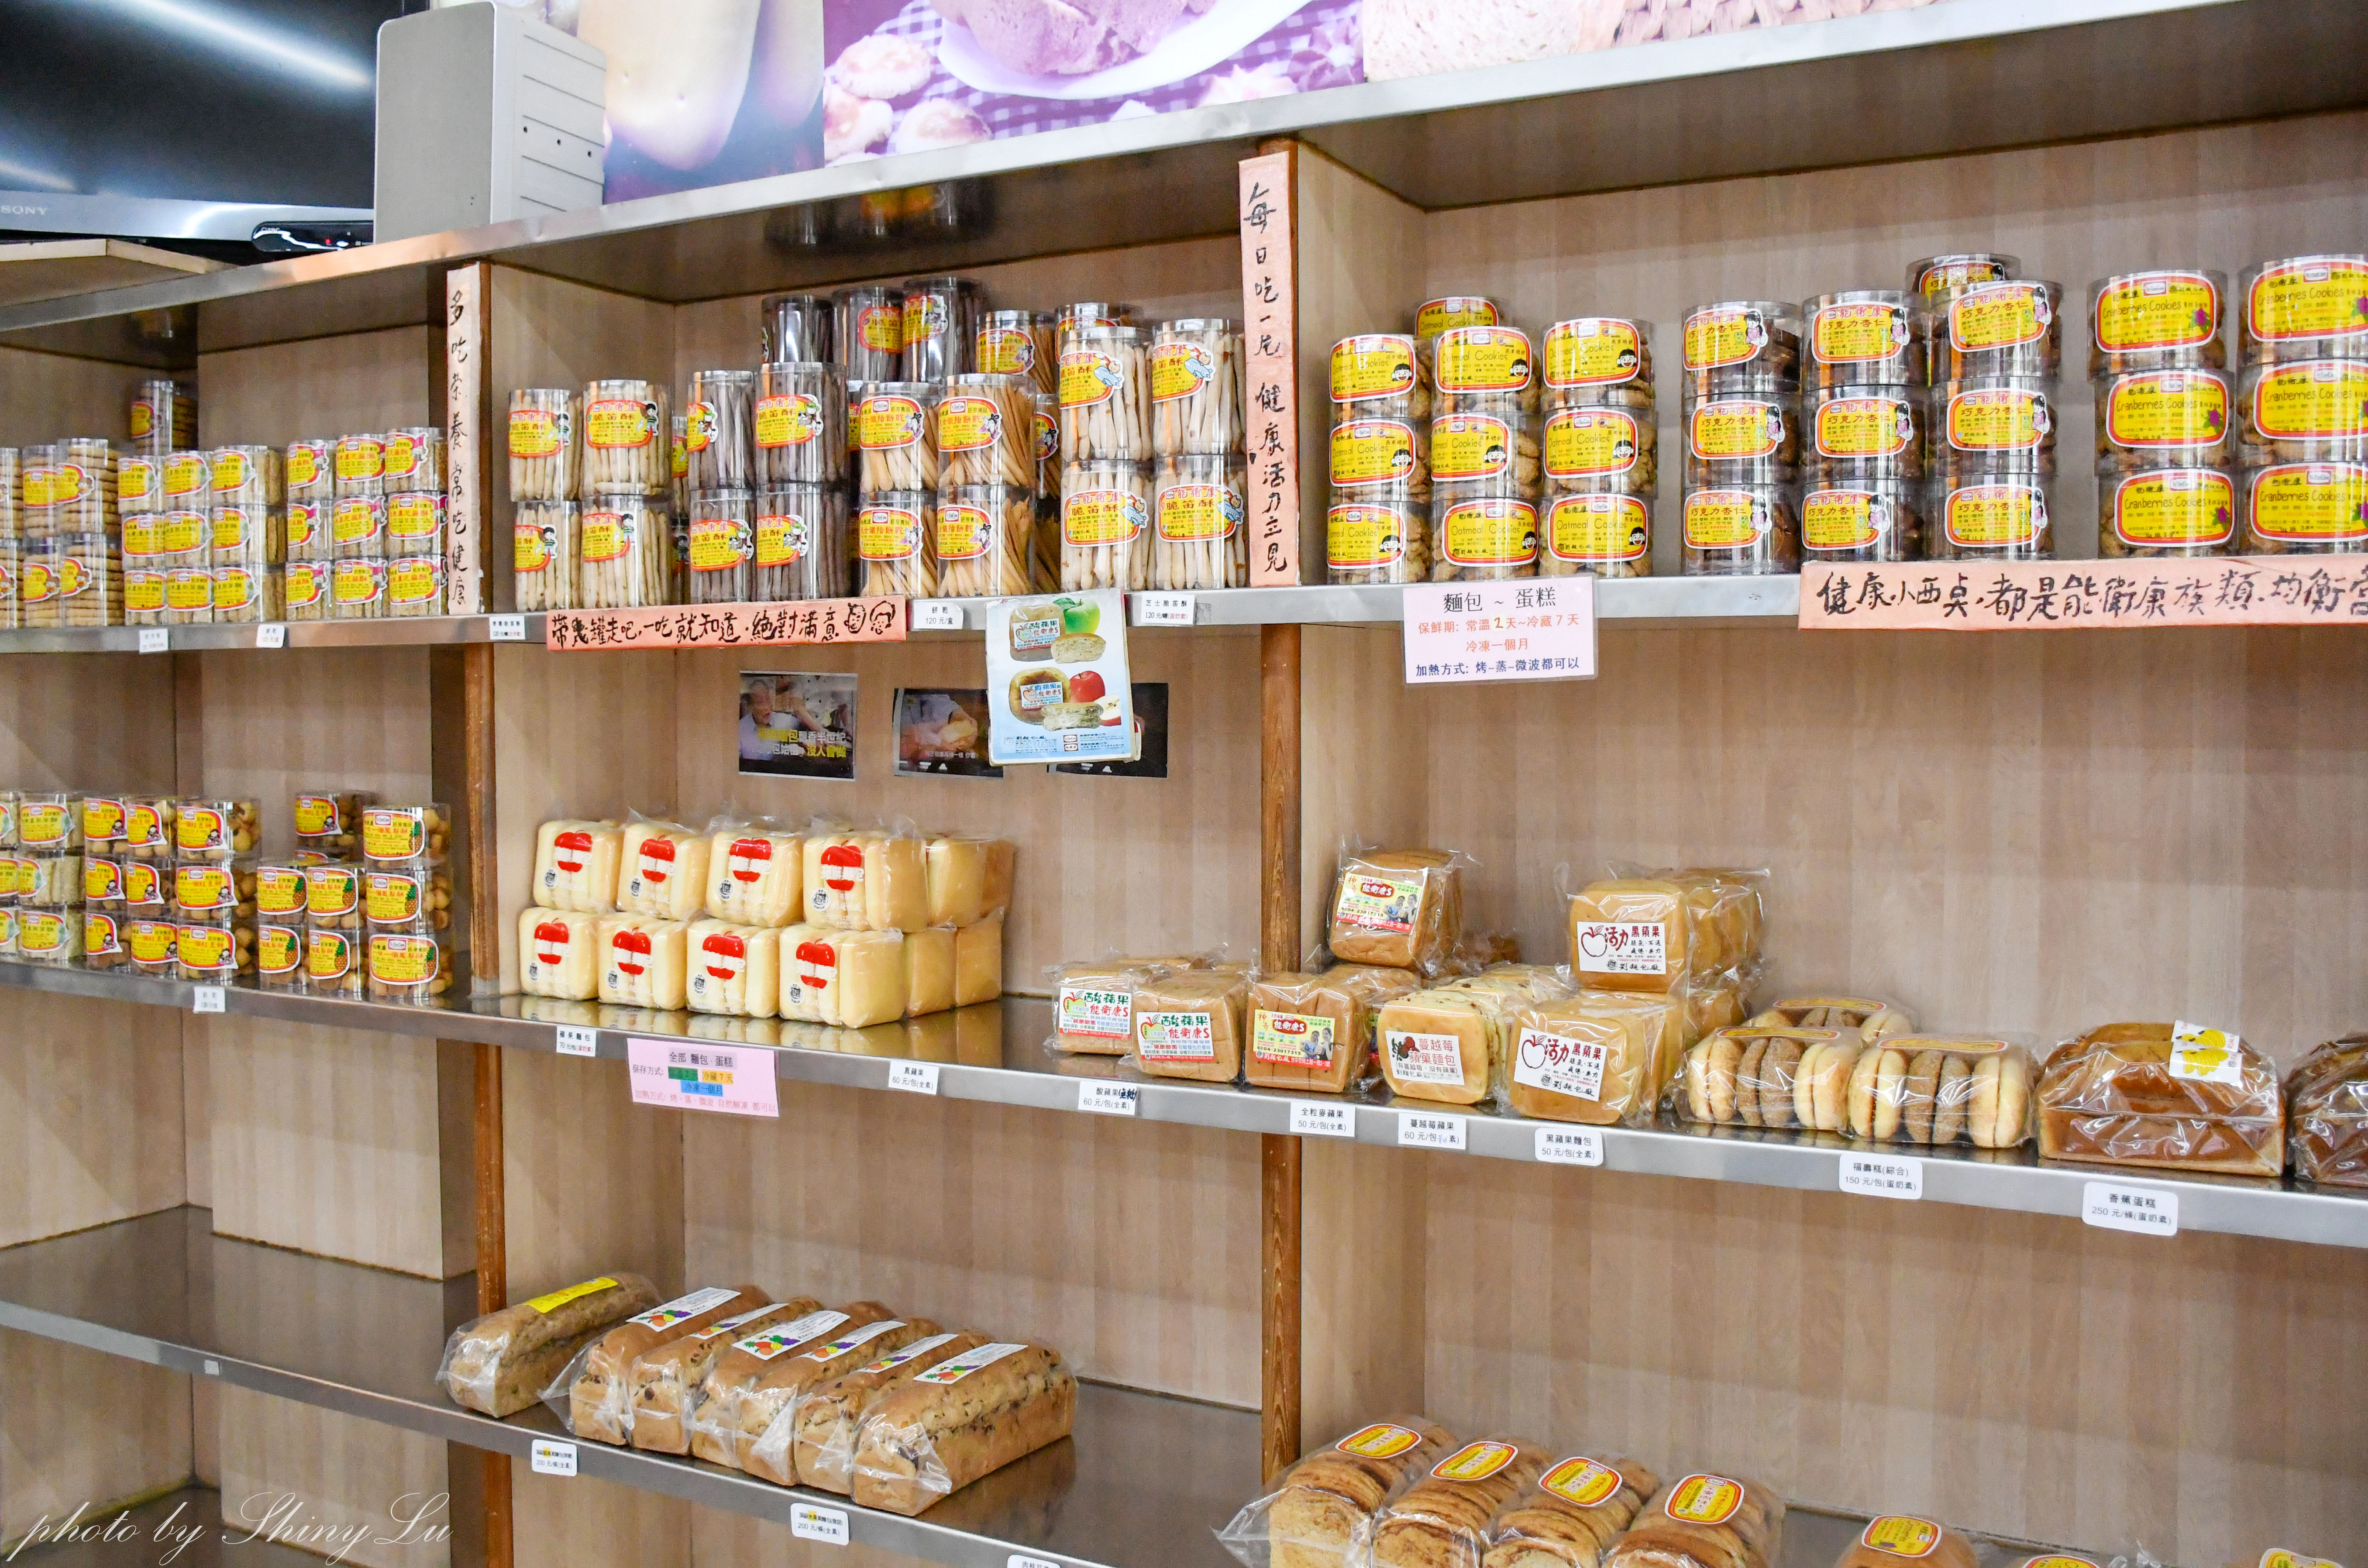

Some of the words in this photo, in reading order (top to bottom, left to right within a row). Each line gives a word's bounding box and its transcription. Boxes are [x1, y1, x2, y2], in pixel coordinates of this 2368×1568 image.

[1978, 288, 2025, 305] 能衛康
[2258, 291, 2306, 305] Cranberries
[2309, 287, 2344, 299] Cookies
[1838, 306, 1884, 318] 能衛康
[1961, 301, 2029, 319] 巧克力杏仁
[2102, 304, 2147, 318] Cranberries
[2149, 299, 2182, 311] Cookies
[1823, 320, 1886, 330] 巧克力杏仁
[1979, 393, 2025, 405] 能衛康
[2265, 390, 2316, 402] Cranberries
[2319, 387, 2353, 399] Cookies
[1844, 401, 1890, 414] 能衛康
[2116, 399, 2164, 412] Cranberries
[2165, 398, 2197, 409] Cookies
[1960, 406, 2028, 417] 巧克力杏仁
[1701, 416, 1762, 427] 巧克力杏仁
[1827, 415, 1891, 424] 巧克力杏仁
[1549, 435, 1572, 448] Oatmeal
[1576, 432, 1611, 444] Cookies
[1332, 447, 1353, 459] Oatmeal
[1357, 443, 1389, 454] Cookies
[1081, 492, 1121, 504] 能衛康
[1177, 486, 1218, 498] 能衛康
[1977, 488, 2022, 501] 能衛康
[2260, 490, 2308, 502] Cranberries
[2311, 488, 2346, 501] Cookies
[1167, 499, 1215, 510] 脆笛酥
[1820, 494, 1860, 505] 能衛康
[2124, 496, 2172, 509] Cranberries
[2175, 496, 2206, 507] Cookies
[1071, 504, 1119, 516] 脆笛酥
[1691, 507, 1746, 516] 巧克力杏仁
[1807, 506, 1864, 517] 巧克力杏仁
[1957, 502, 2027, 512] 巧克力杏仁
[1451, 524, 1484, 536] Oatmeal
[1488, 523, 1520, 534] Cookies
[1556, 518, 1589, 530] Oatmeal
[1594, 518, 1627, 530] Cookies
[1145, 598, 1187, 608] 芝士脆笛酥
[1443, 591, 1483, 613] 麵包
[1515, 586, 1556, 609] 蛋糕
[932, 605, 948, 614] 餅乾
[938, 617, 953, 625] 元/盒
[1418, 621, 1459, 635] 保鮮期:
[1466, 638, 1529, 653] 冷凍一個月
[1416, 662, 1469, 677] 加熱方式:
[1362, 883, 1393, 896] 能衛康S
[1631, 925, 1660, 938] 黑蘋果
[1605, 926, 1629, 951] 活力
[1619, 963, 1662, 971] 劉麵包廠
[1084, 992, 1129, 1004] 酸蘋果
[1090, 1005, 1128, 1017] 能衛康S
[1161, 1015, 1208, 1027] 酸蘋果
[1274, 1020, 1305, 1032] 能衛康S
[560, 1030, 591, 1042] 蘋果麵包
[1168, 1027, 1210, 1039] 能衛康S
[1418, 1038, 1453, 1052] 蔓越莓
[1571, 1042, 1602, 1060] 黑蘋果
[669, 1052, 686, 1063] 全部
[1544, 1038, 1569, 1066] 活力
[633, 1064, 664, 1076] 保存方式:
[904, 1066, 924, 1076] 真蘋果
[684, 1082, 723, 1094] 冷凍一個月
[902, 1077, 933, 1090] 元/包(全素)
[1552, 1080, 1595, 1097] 劉麵包廠
[1083, 1097, 1092, 1106] 60
[1094, 1098, 1130, 1111] 元/包(全素)
[1301, 1107, 1343, 1118] 全粒麥蘋果
[1298, 1120, 1307, 1128] 50
[1309, 1120, 1346, 1133] 元/包(全素)
[1410, 1118, 1455, 1131] 蔓越莓蘋果
[1404, 1131, 1415, 1140] 60
[1546, 1134, 1591, 1146] 黑蘋果麵包
[1553, 1148, 1595, 1160] 元/包(全素)
[1853, 1162, 1909, 1177] 福壽糕(綜合)
[1862, 1177, 1917, 1192] 元/包(蛋奶素)
[2109, 1193, 2157, 1209] 香蕉蛋糕
[2092, 1206, 2108, 1216] 250
[2111, 1208, 2172, 1225] 元/條(蛋奶素)
